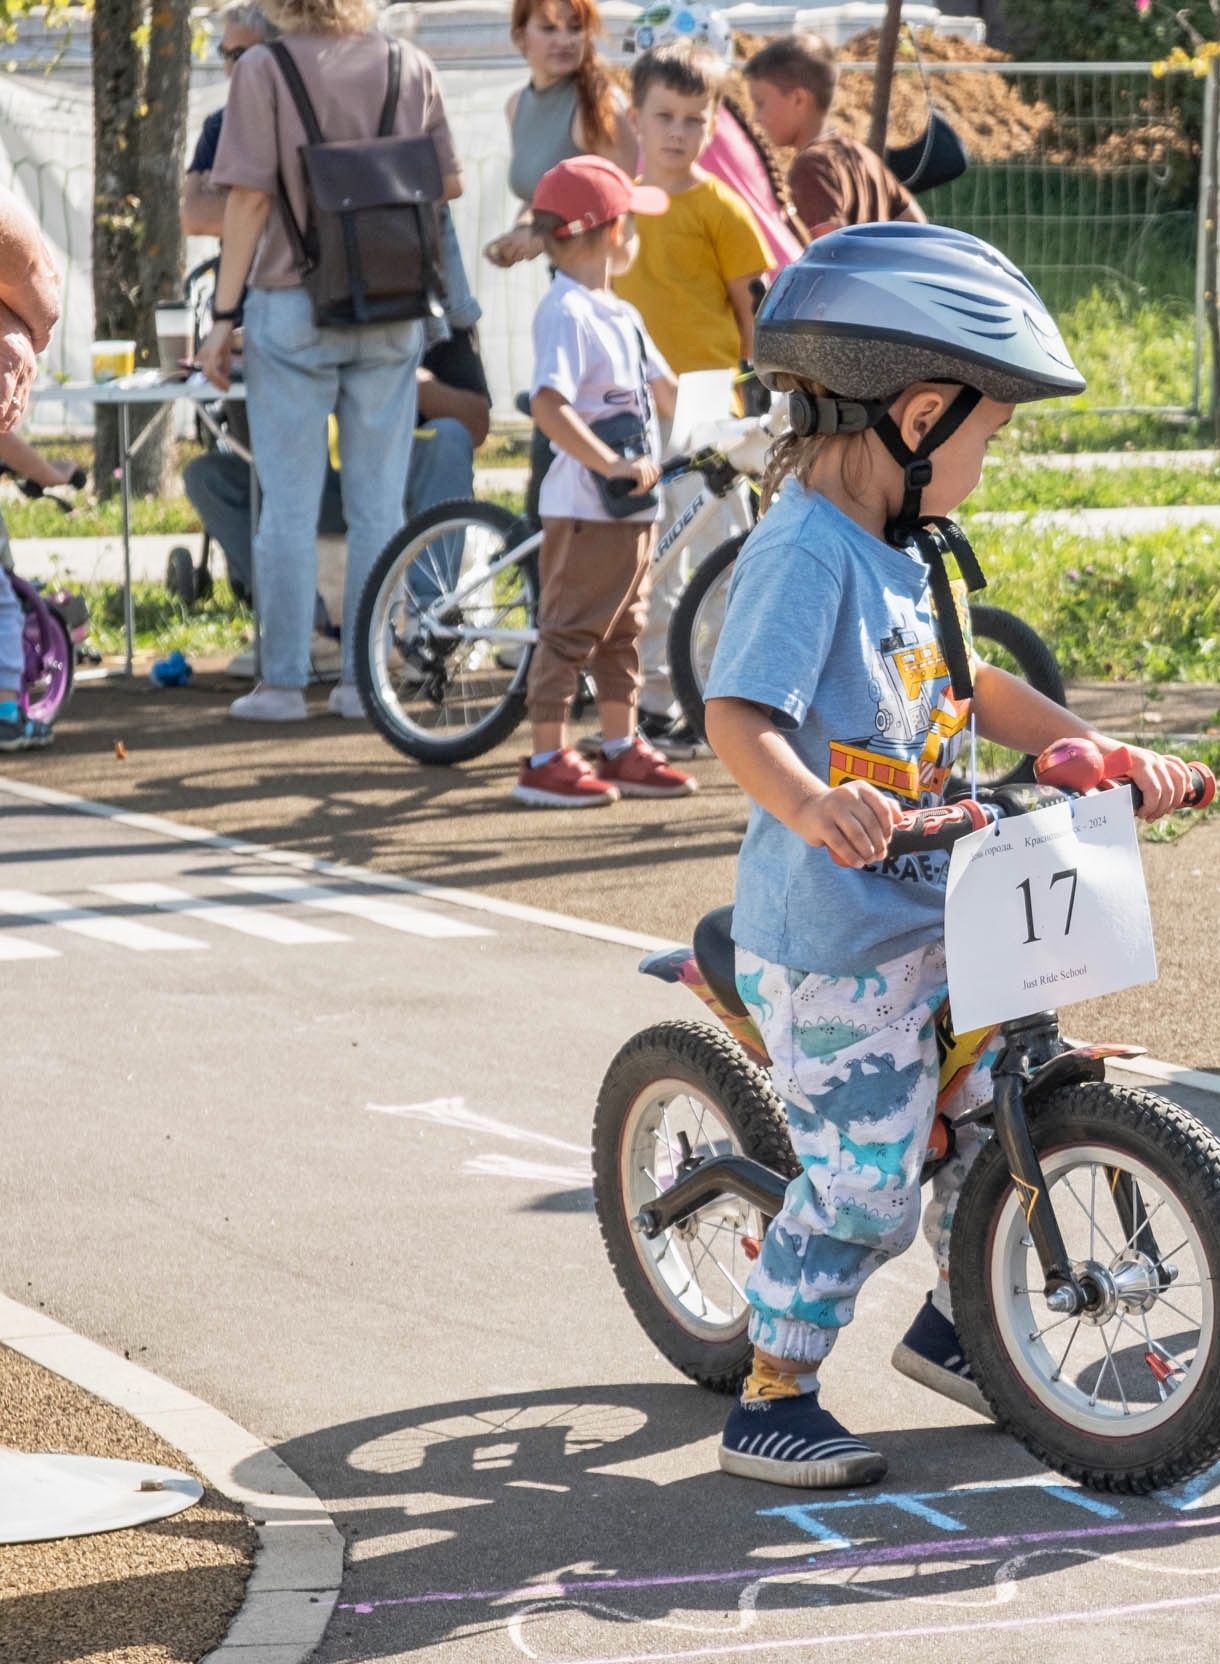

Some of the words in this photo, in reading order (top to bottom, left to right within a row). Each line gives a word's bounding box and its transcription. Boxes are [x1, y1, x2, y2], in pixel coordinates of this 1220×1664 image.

[1088, 815, 1108, 831] 2024
[1015, 867, 1078, 944] 17
[1022, 978, 1039, 991] Just
[1040, 972, 1059, 986] Ride
[1060, 965, 1088, 980] School
